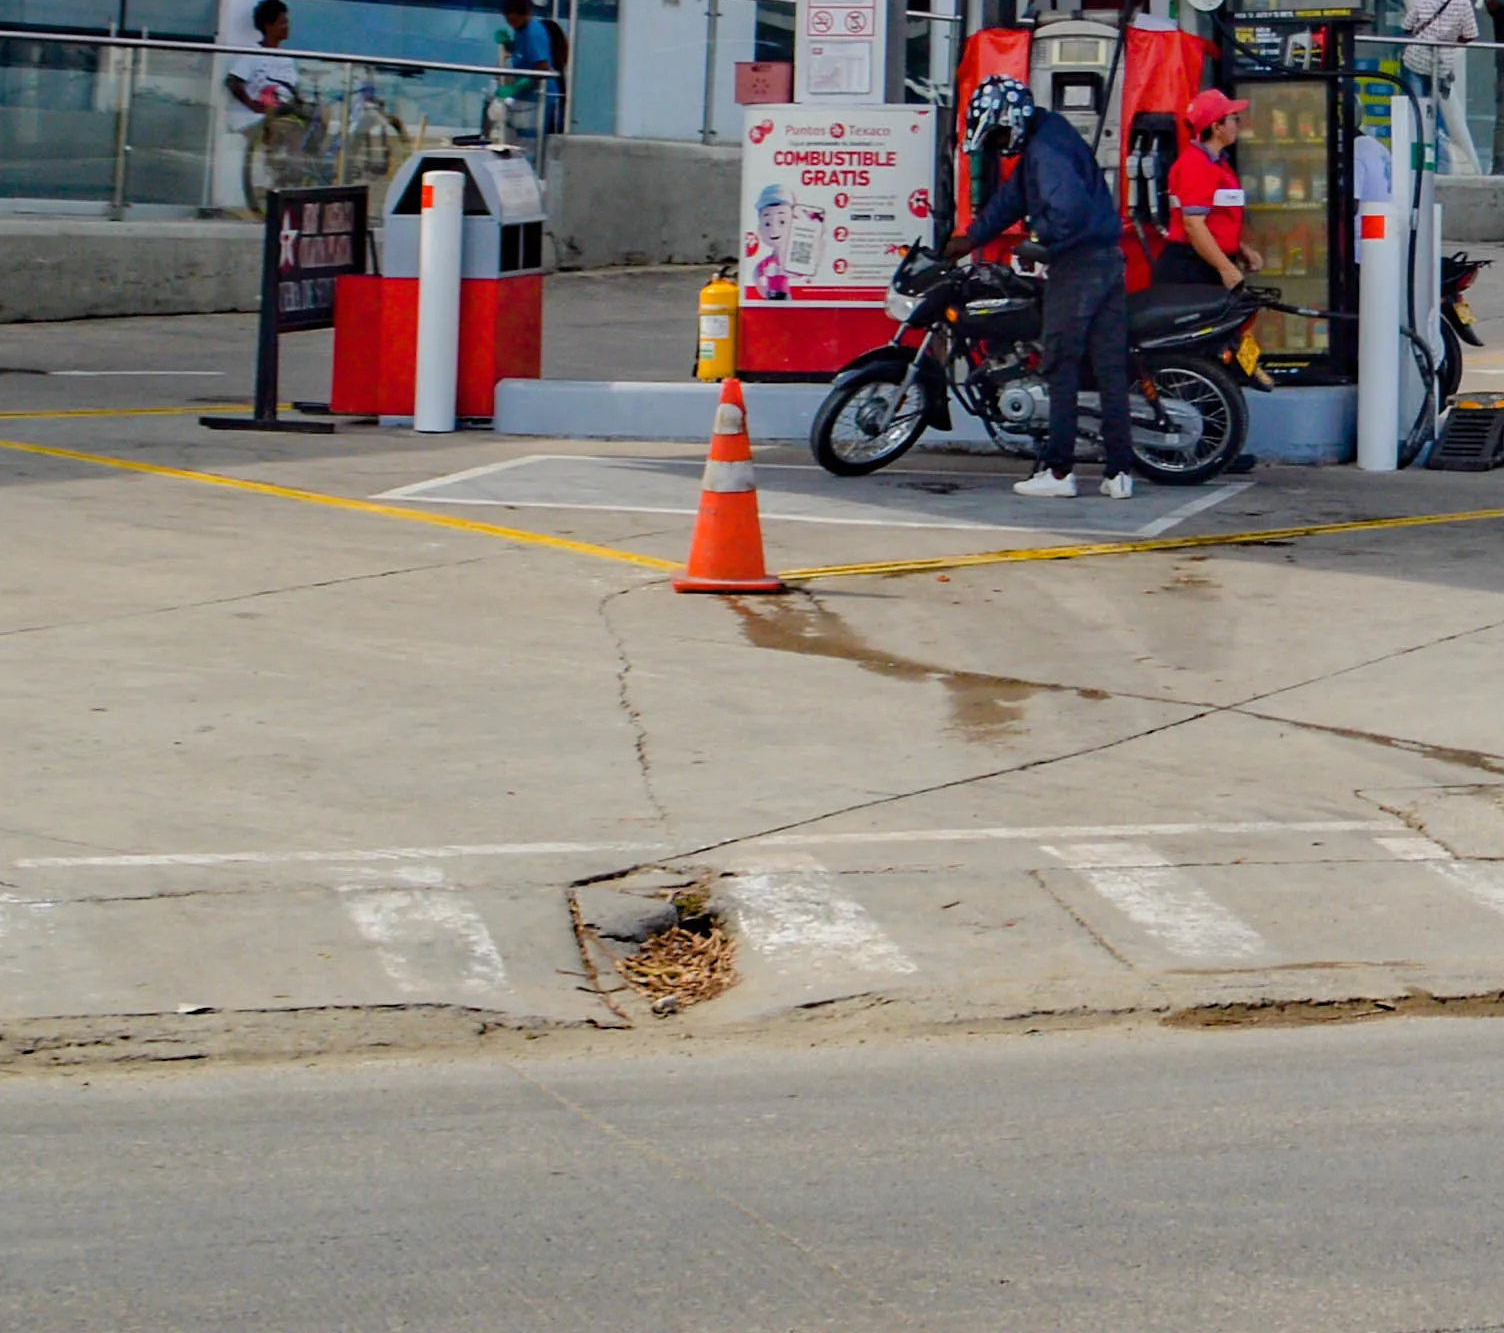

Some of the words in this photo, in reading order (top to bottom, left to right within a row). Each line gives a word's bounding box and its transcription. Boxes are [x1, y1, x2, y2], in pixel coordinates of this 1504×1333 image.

[785, 124, 826, 137] Puntos
[849, 125, 891, 137] Texaco
[774, 150, 898, 167] COMBUSTIBLE
[801, 170, 871, 187] GRATIS
